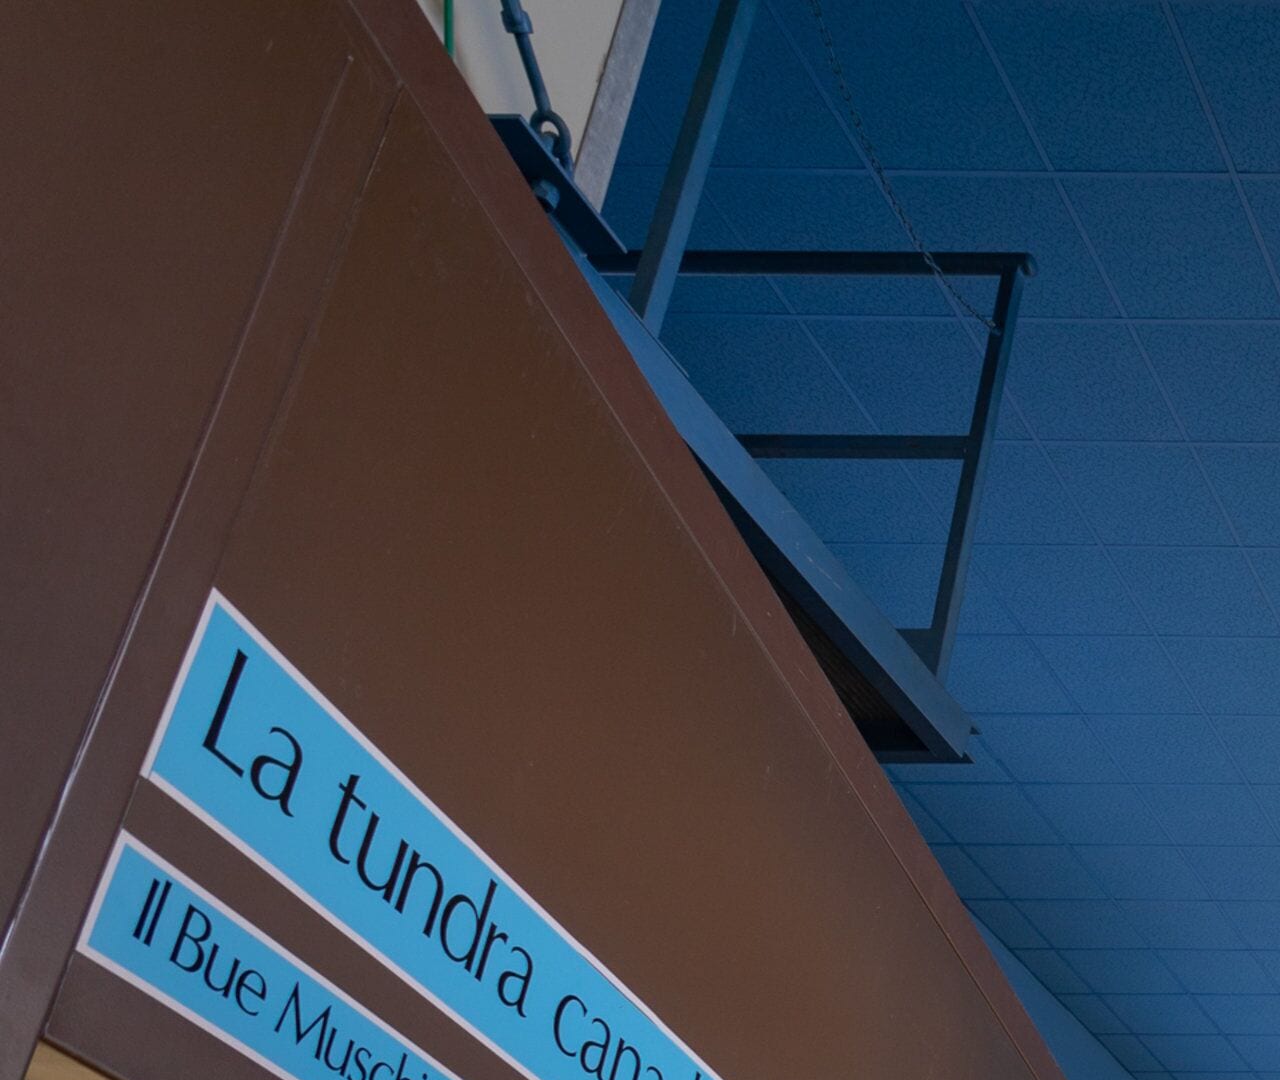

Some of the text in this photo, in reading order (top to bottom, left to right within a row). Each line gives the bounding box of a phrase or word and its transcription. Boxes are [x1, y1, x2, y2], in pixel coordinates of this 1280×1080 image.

[132, 878, 173, 947] Il
[169, 904, 267, 1016] Bue
[202, 648, 304, 817] La
[328, 774, 534, 1018] tundra
